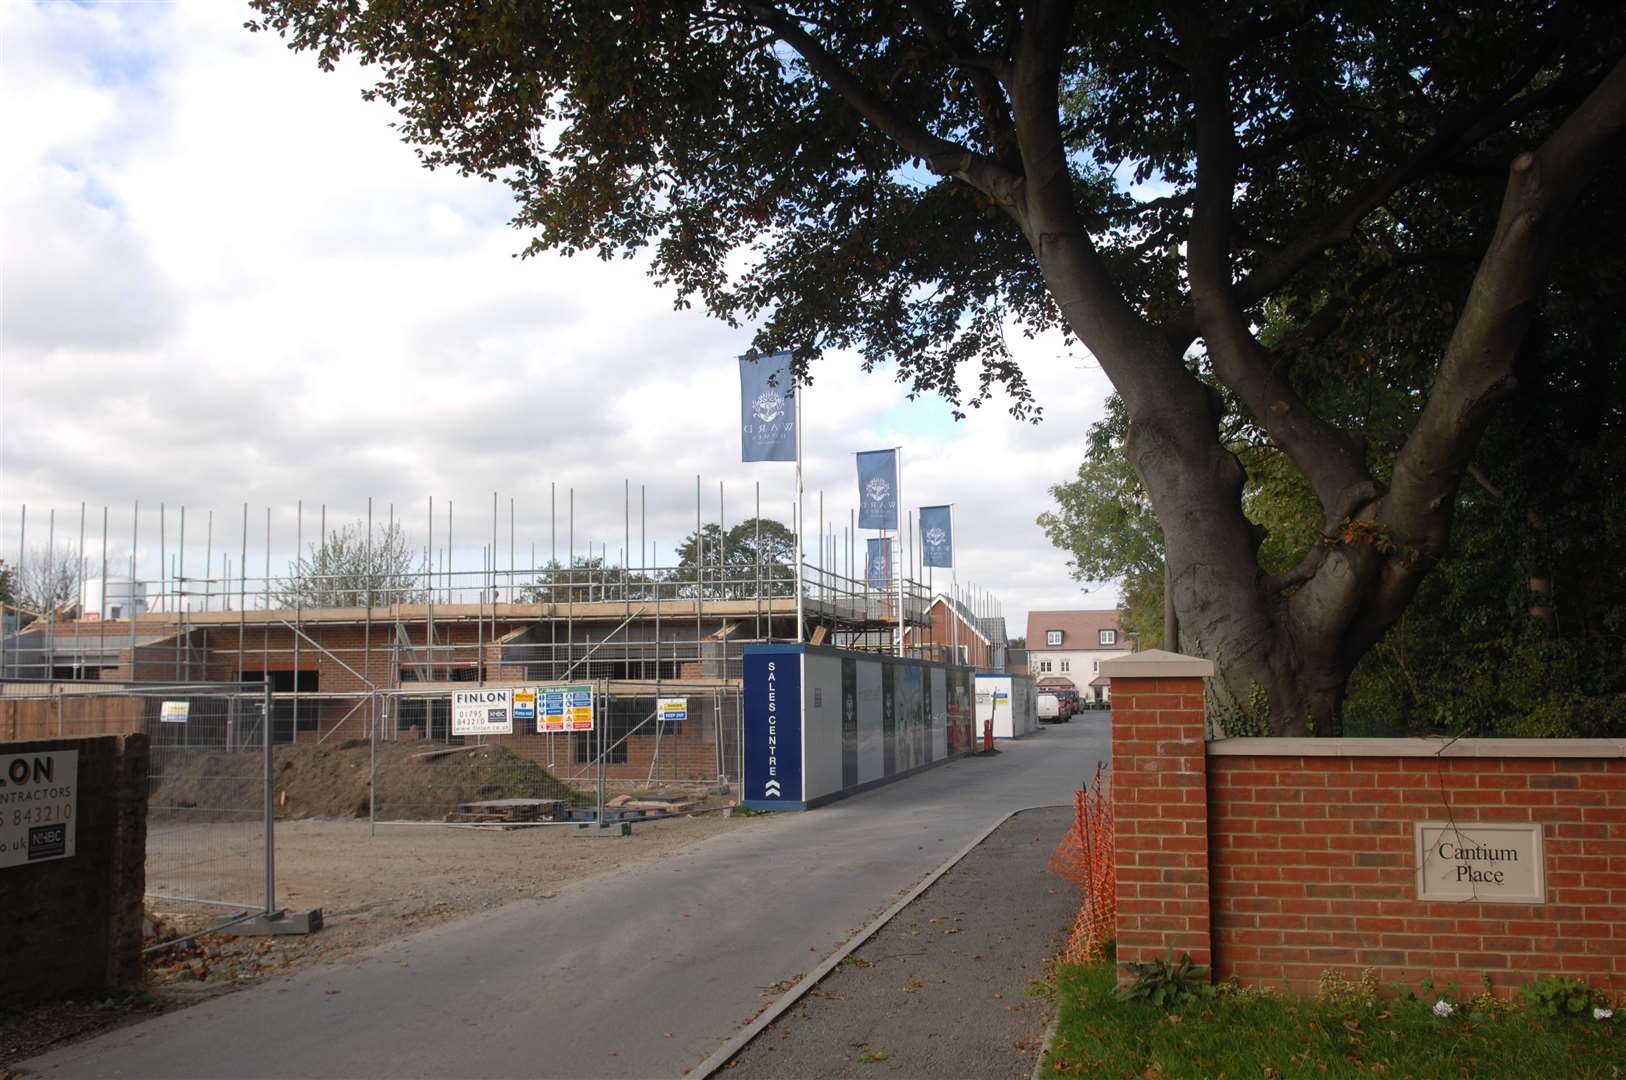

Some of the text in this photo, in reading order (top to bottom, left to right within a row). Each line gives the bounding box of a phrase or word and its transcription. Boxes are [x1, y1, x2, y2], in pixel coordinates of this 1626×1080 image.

[456, 692, 506, 703] FINLON
[768, 662, 777, 776] SALES CENTRE
[13, 802, 72, 826] 843210
[32, 830, 62, 846] NHBC
[1439, 842, 1518, 861] Cantium
[1456, 866, 1504, 883] Place
